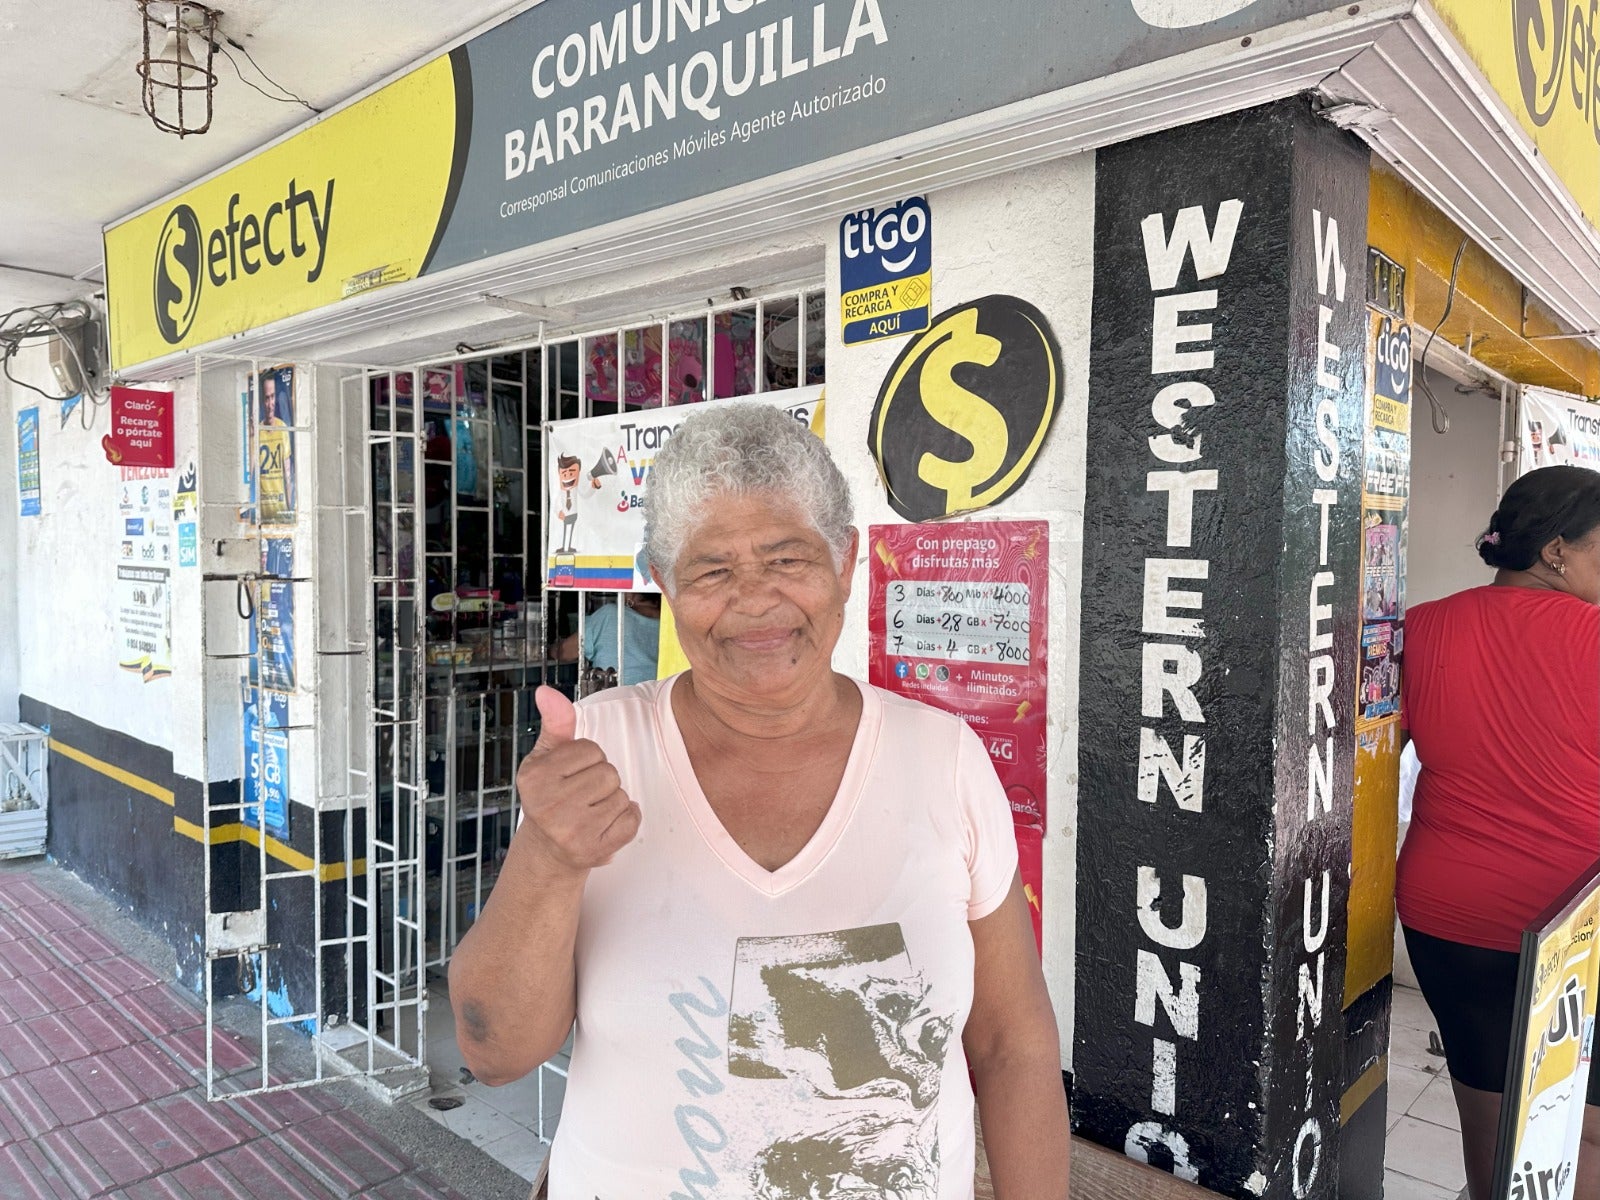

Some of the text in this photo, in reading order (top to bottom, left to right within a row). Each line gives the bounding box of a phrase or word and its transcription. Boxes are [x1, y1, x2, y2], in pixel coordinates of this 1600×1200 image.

[505, 0, 889, 180] BARRANQUILLA
[500, 75, 886, 218] Corresponsal Comunicaciones Móviles Agente Autorizado
[207, 178, 335, 287] efecty
[844, 285, 898, 307] COMPRA Y
[844, 299, 893, 319] RECARGA
[869, 313, 901, 336] AQUÍ
[124, 400, 152, 411] Claro
[120, 416, 159, 429] Recarga
[125, 427, 163, 438] pórtate
[130, 438, 152, 449] aquí
[620, 424, 678, 451] Tran
[616, 445, 656, 486] A V
[1137, 198, 1244, 813] WESTERN
[1307, 209, 1347, 821] WESTERN
[916, 536, 996, 553] Con prepago
[912, 554, 1000, 568] disfrutas más
[894, 584, 905, 602] 3
[916, 587, 936, 598] Días
[965, 589, 981, 599] Mb
[893, 609, 905, 629] 6
[916, 614, 935, 624] Días
[966, 616, 980, 627] GB
[892, 634, 904, 655] 7
[916, 640, 936, 651] Días
[945, 638, 959, 658] 4
[967, 644, 980, 655] GB
[971, 669, 1014, 683] Minutos
[902, 681, 949, 692] Redes incluidas
[966, 681, 1018, 696] ilimitados
[990, 742, 1014, 760] 4G
